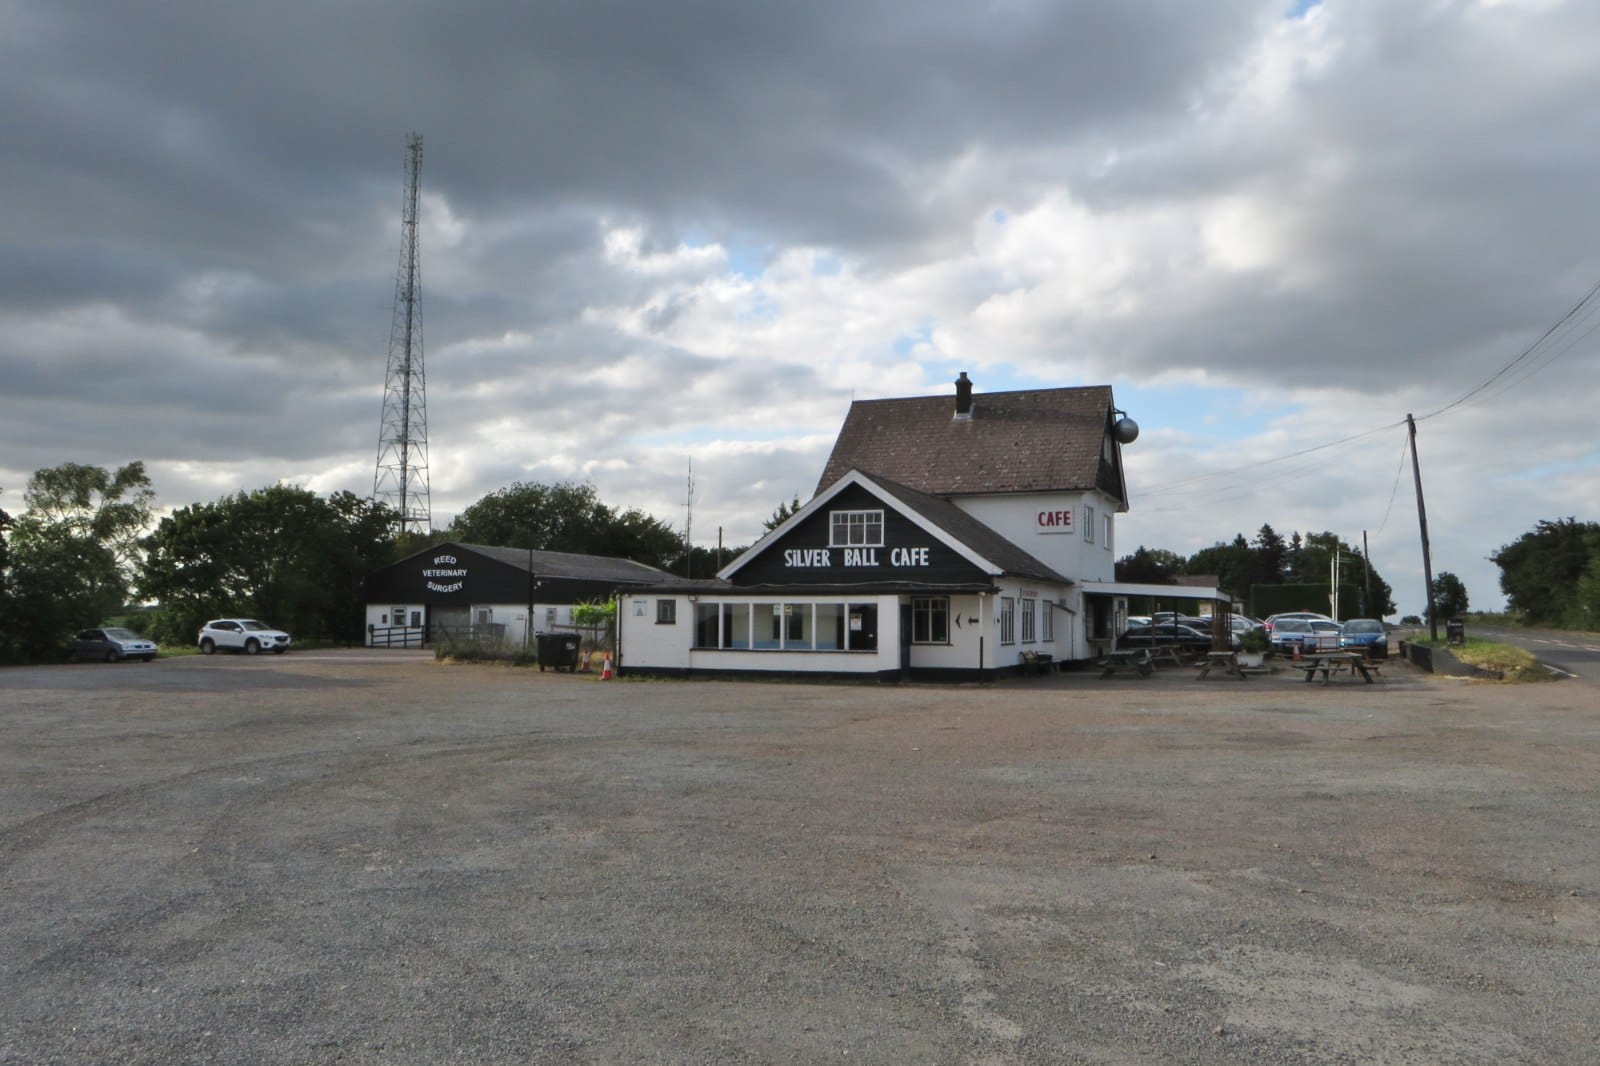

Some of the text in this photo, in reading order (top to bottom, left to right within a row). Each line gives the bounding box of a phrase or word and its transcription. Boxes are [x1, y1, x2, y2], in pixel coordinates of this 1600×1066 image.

[1038, 511, 1072, 526] CAFE
[433, 555, 457, 566] REED
[844, 548, 880, 567] BALL
[890, 547, 930, 567] CAFE
[422, 569, 468, 577] VETERINARY
[426, 580, 463, 593] SURGERY
